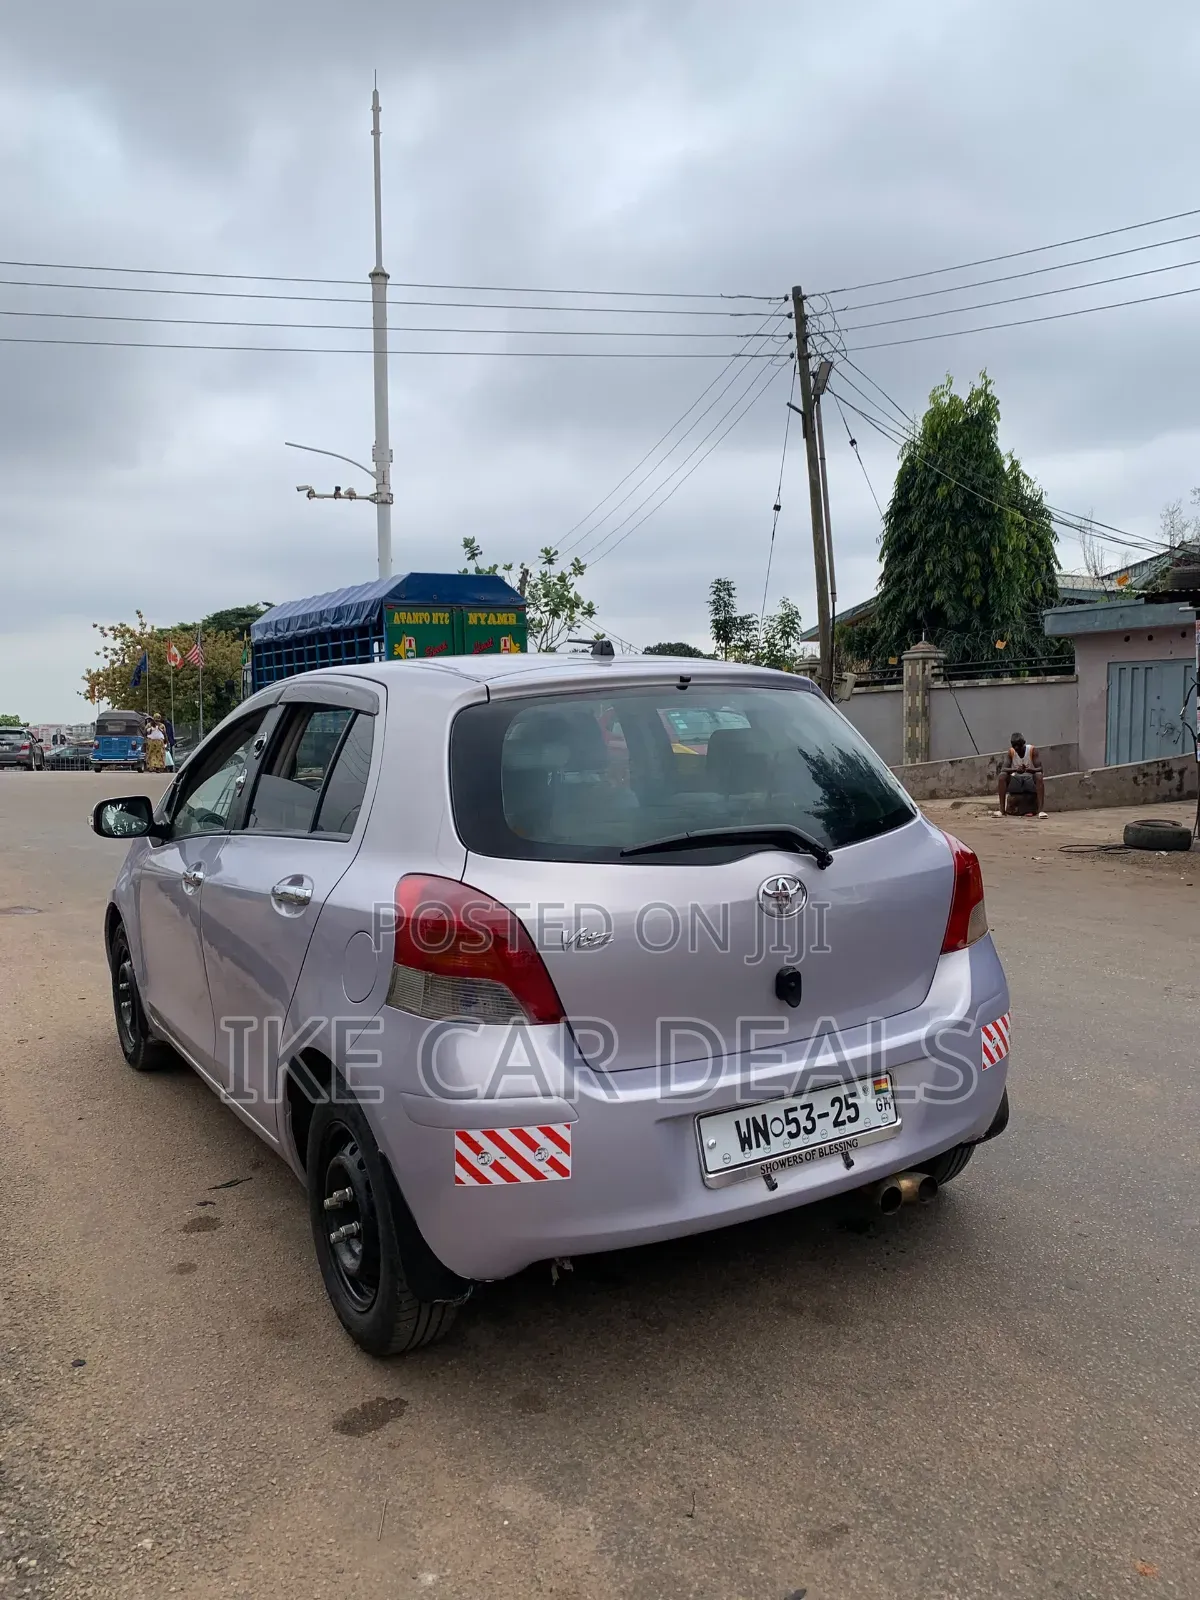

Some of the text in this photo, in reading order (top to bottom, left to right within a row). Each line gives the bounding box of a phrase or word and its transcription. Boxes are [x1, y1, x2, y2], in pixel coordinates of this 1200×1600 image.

[561, 927, 615, 952] Vitz
[760, 1153, 804, 1175] SHOWERS
[804, 1149, 816, 1162] OF
[818, 1138, 859, 1158] BLESSING
